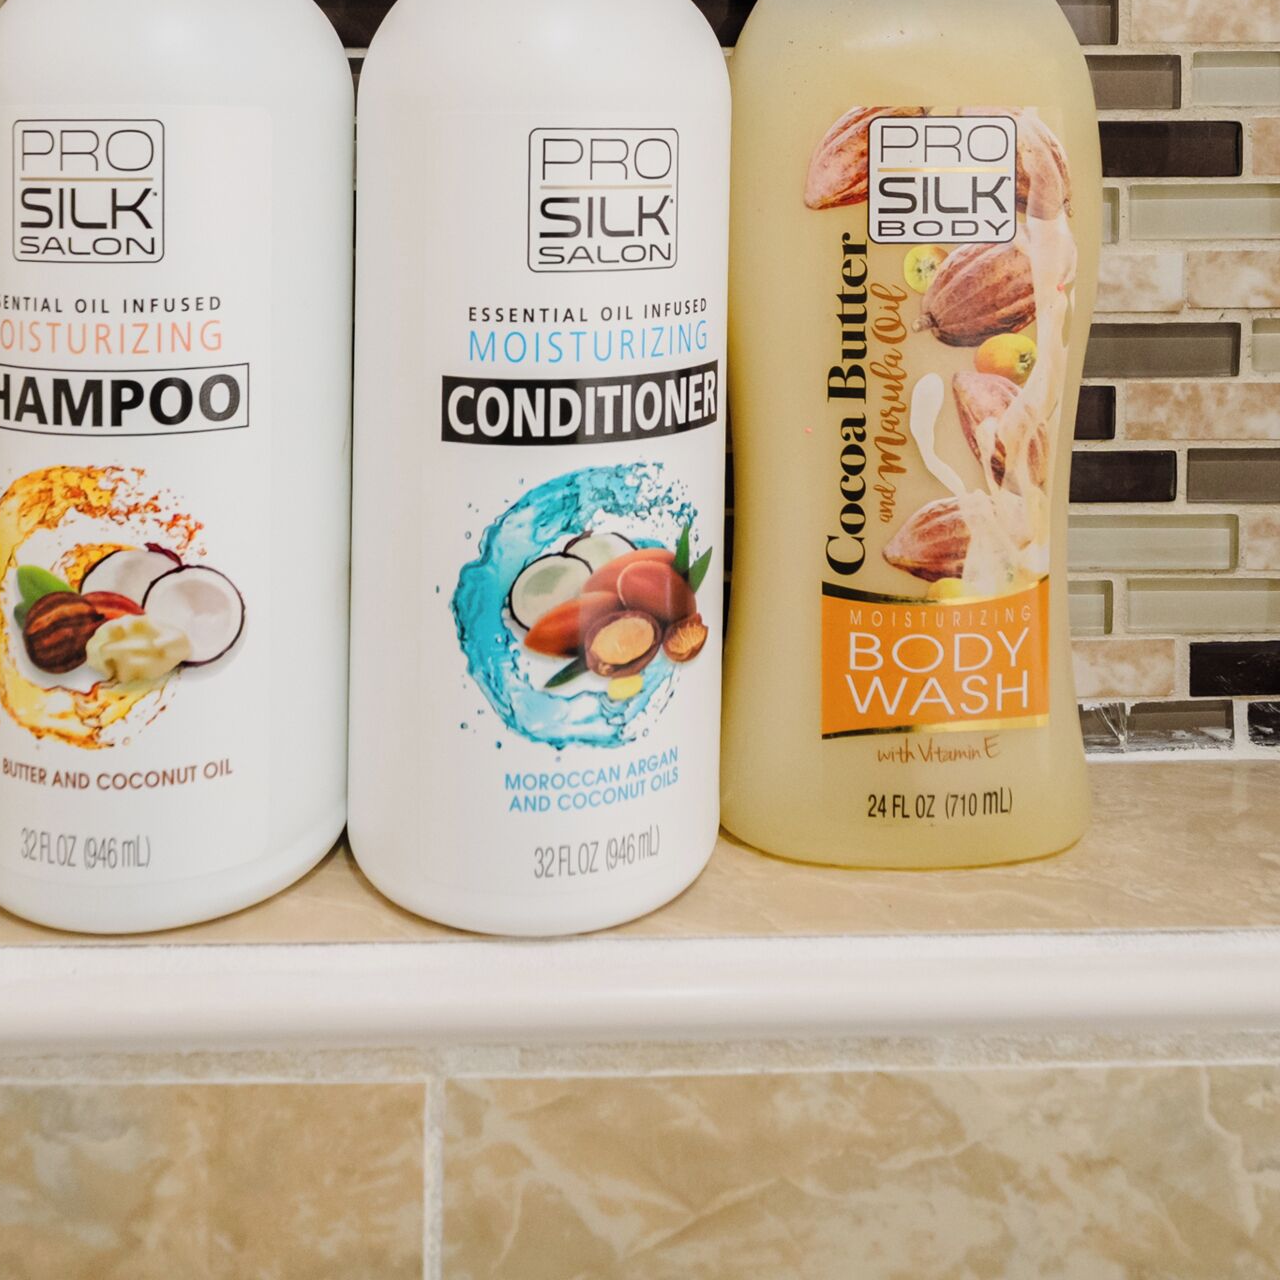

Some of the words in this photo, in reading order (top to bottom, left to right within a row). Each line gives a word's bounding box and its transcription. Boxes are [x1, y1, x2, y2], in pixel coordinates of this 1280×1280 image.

[21, 129, 154, 171] PRO
[542, 137, 672, 180] PRO
[880, 124, 1009, 163] PRO
[20, 187, 154, 230] SILK
[539, 194, 671, 238] SILK
[878, 176, 1010, 215] SILK
[20, 236, 156, 256] SALON
[878, 219, 1011, 237] BODY
[538, 242, 672, 265] SALON
[74, 298, 110, 314] OIL
[122, 296, 222, 314] INFUSED
[468, 306, 588, 323] ESSENTIAL
[600, 305, 633, 321] OIL
[644, 297, 708, 319] INFUSED
[826, 231, 869, 404] Butter
[870, 282, 909, 345] Oil
[469, 319, 708, 363] MOISTURIZING
[447, 370, 717, 438] CONDITIONER
[869, 348, 908, 475] Marula
[825, 413, 868, 576] Cocoa
[872, 479, 897, 524] and
[849, 604, 1032, 629] MOISTURIZING
[848, 626, 1029, 674] BODY
[844, 670, 1029, 717] WASH
[504, 764, 621, 792] MOROCCAN
[625, 746, 679, 780] ARGAN
[877, 737, 916, 763] with
[917, 737, 981, 763] Vitamin
[984, 734, 1001, 759] E
[2, 757, 47, 786] BUTTER
[51, 770, 90, 791] AND
[96, 764, 199, 791] COCONUT
[203, 758, 234, 780] OIL
[508, 795, 551, 813] AND
[557, 779, 646, 812] COCONUT
[650, 766, 680, 793] OILS
[867, 793, 888, 818] 24
[892, 793, 911, 819] FL
[915, 793, 936, 819] OZ
[944, 792, 978, 818] (710
[982, 786, 1013, 816] mL)
[83, 836, 118, 869] (946
[122, 835, 152, 868] mL)
[533, 846, 555, 879] 32
[558, 844, 577, 877] FL
[578, 841, 600, 875] OZ
[605, 832, 636, 871] (946
[638, 824, 660, 860] mL)
